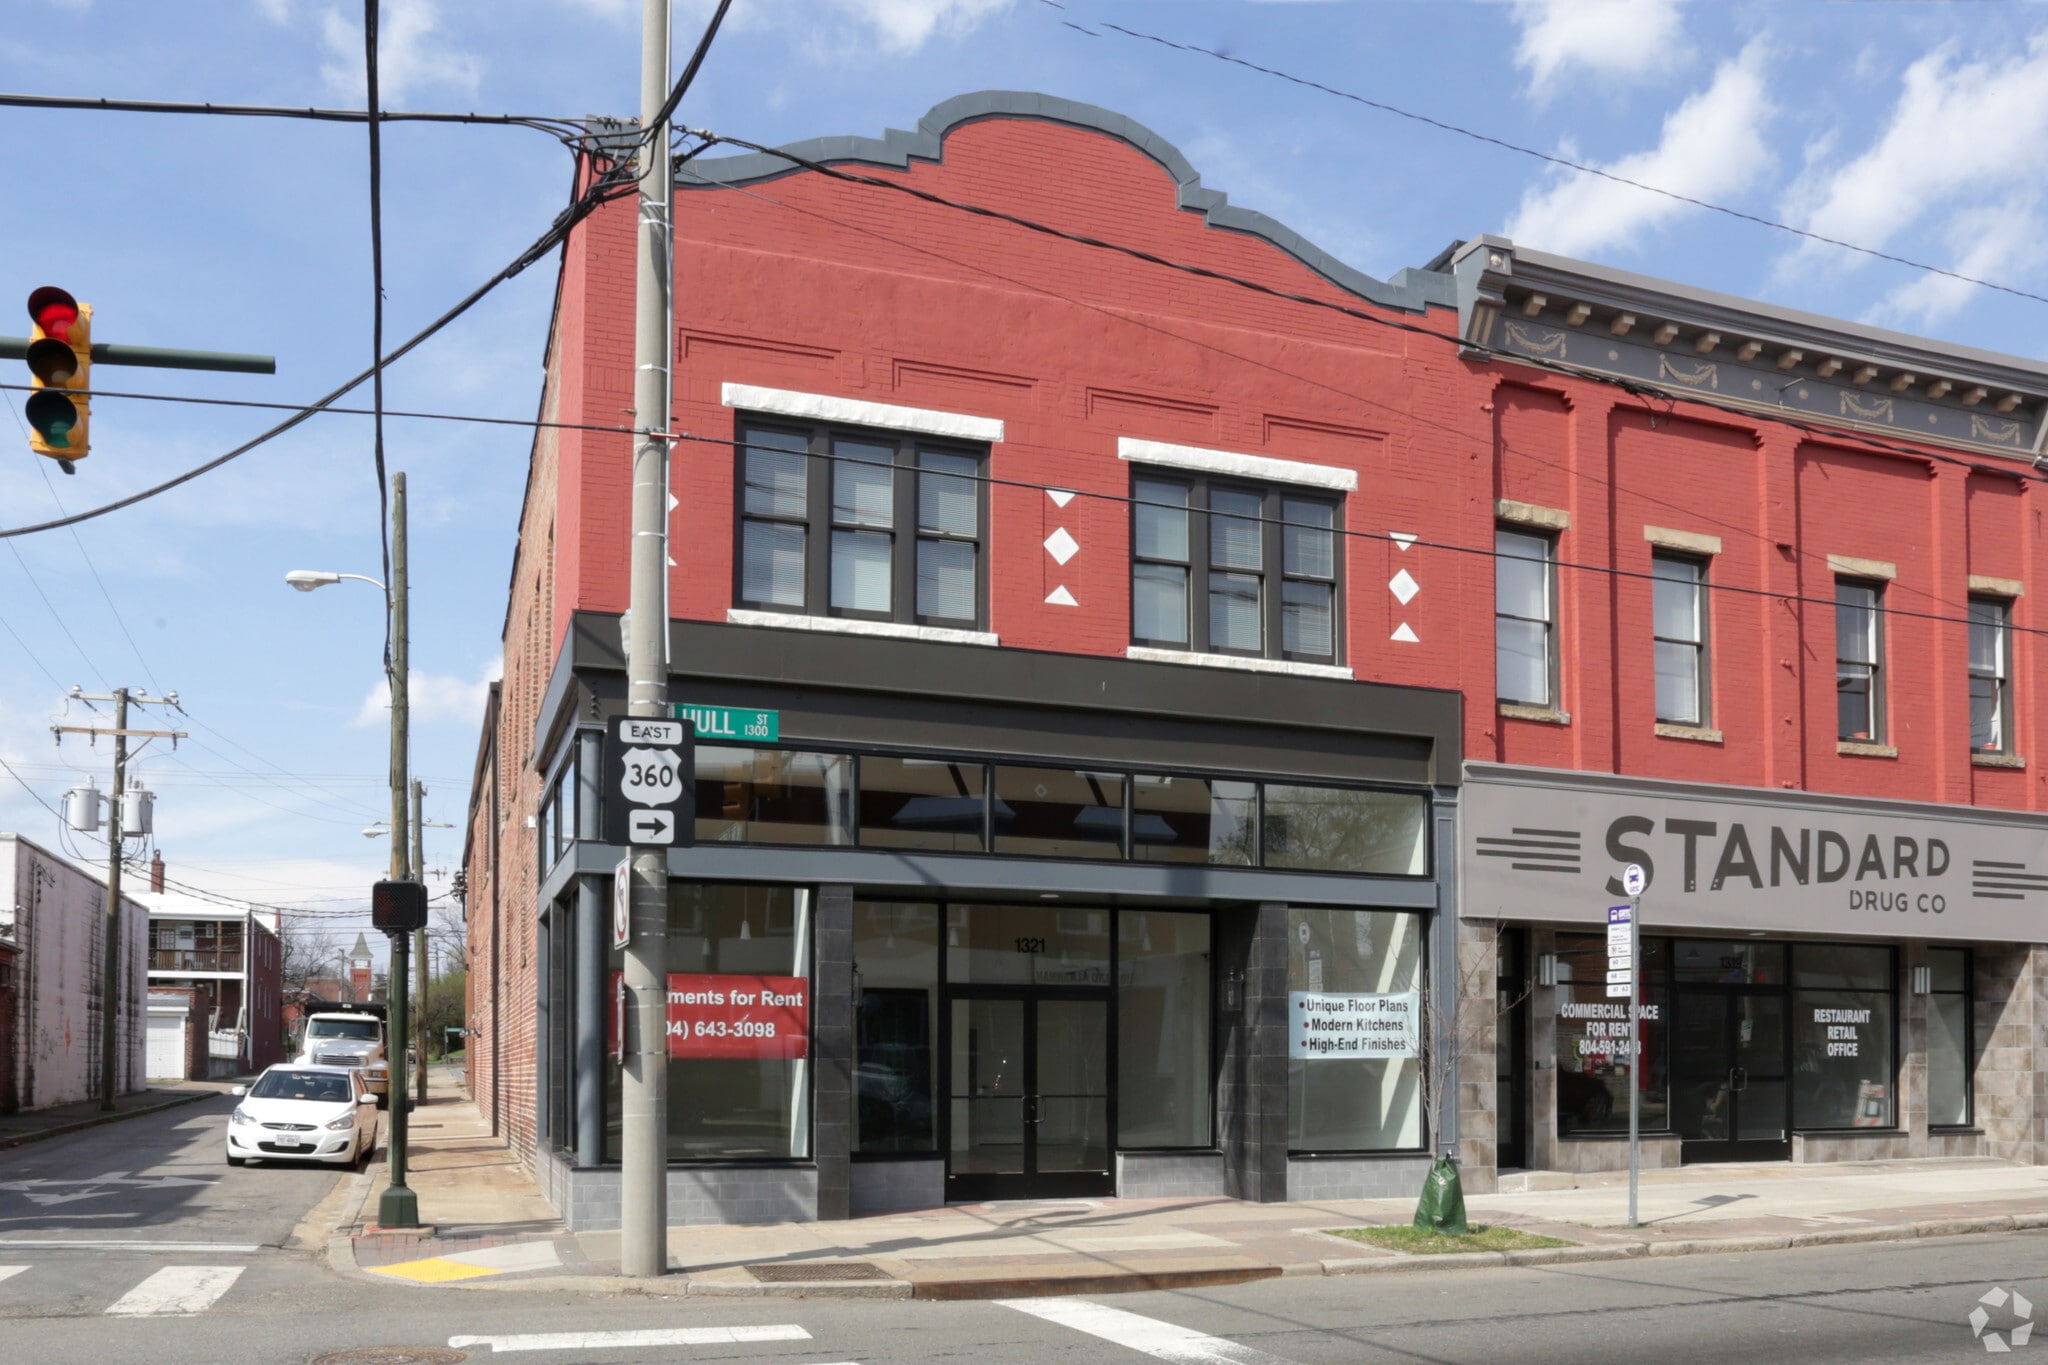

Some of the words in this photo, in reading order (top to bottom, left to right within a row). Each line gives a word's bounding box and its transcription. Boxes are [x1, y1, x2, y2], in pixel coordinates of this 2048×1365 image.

[756, 713, 769, 726] ST
[630, 725, 672, 739] EAST
[744, 724, 769, 737] 1300
[629, 764, 673, 788] 360
[1604, 814, 1951, 898] STANDARD
[1849, 888, 1909, 913] DRUG
[1916, 893, 1947, 914] CO
[1014, 937, 1046, 954] 1321
[666, 989, 725, 1006] ments
[729, 989, 757, 1006] for
[761, 990, 803, 1007] Rent
[1306, 998, 1345, 1015] Unique
[1348, 998, 1376, 1013] Floor
[1379, 999, 1409, 1014] Plans
[1561, 1003, 1626, 1019] COMMERCIAL
[1628, 1004, 1659, 1019] ACE
[1814, 1008, 1871, 1023] RESTAURANT
[694, 1021, 776, 1038] 643-3098
[1311, 1018, 1353, 1032] Modern
[1356, 1018, 1404, 1032] Kitchens
[1586, 1021, 1607, 1037] FOR
[1827, 1025, 1858, 1040] RETAIL
[1309, 1037, 1358, 1053] High-End
[1361, 1037, 1407, 1051] Finishes
[1578, 1039, 1642, 1056] 804-591-24
[1827, 1042, 1859, 1057] OFFICE
